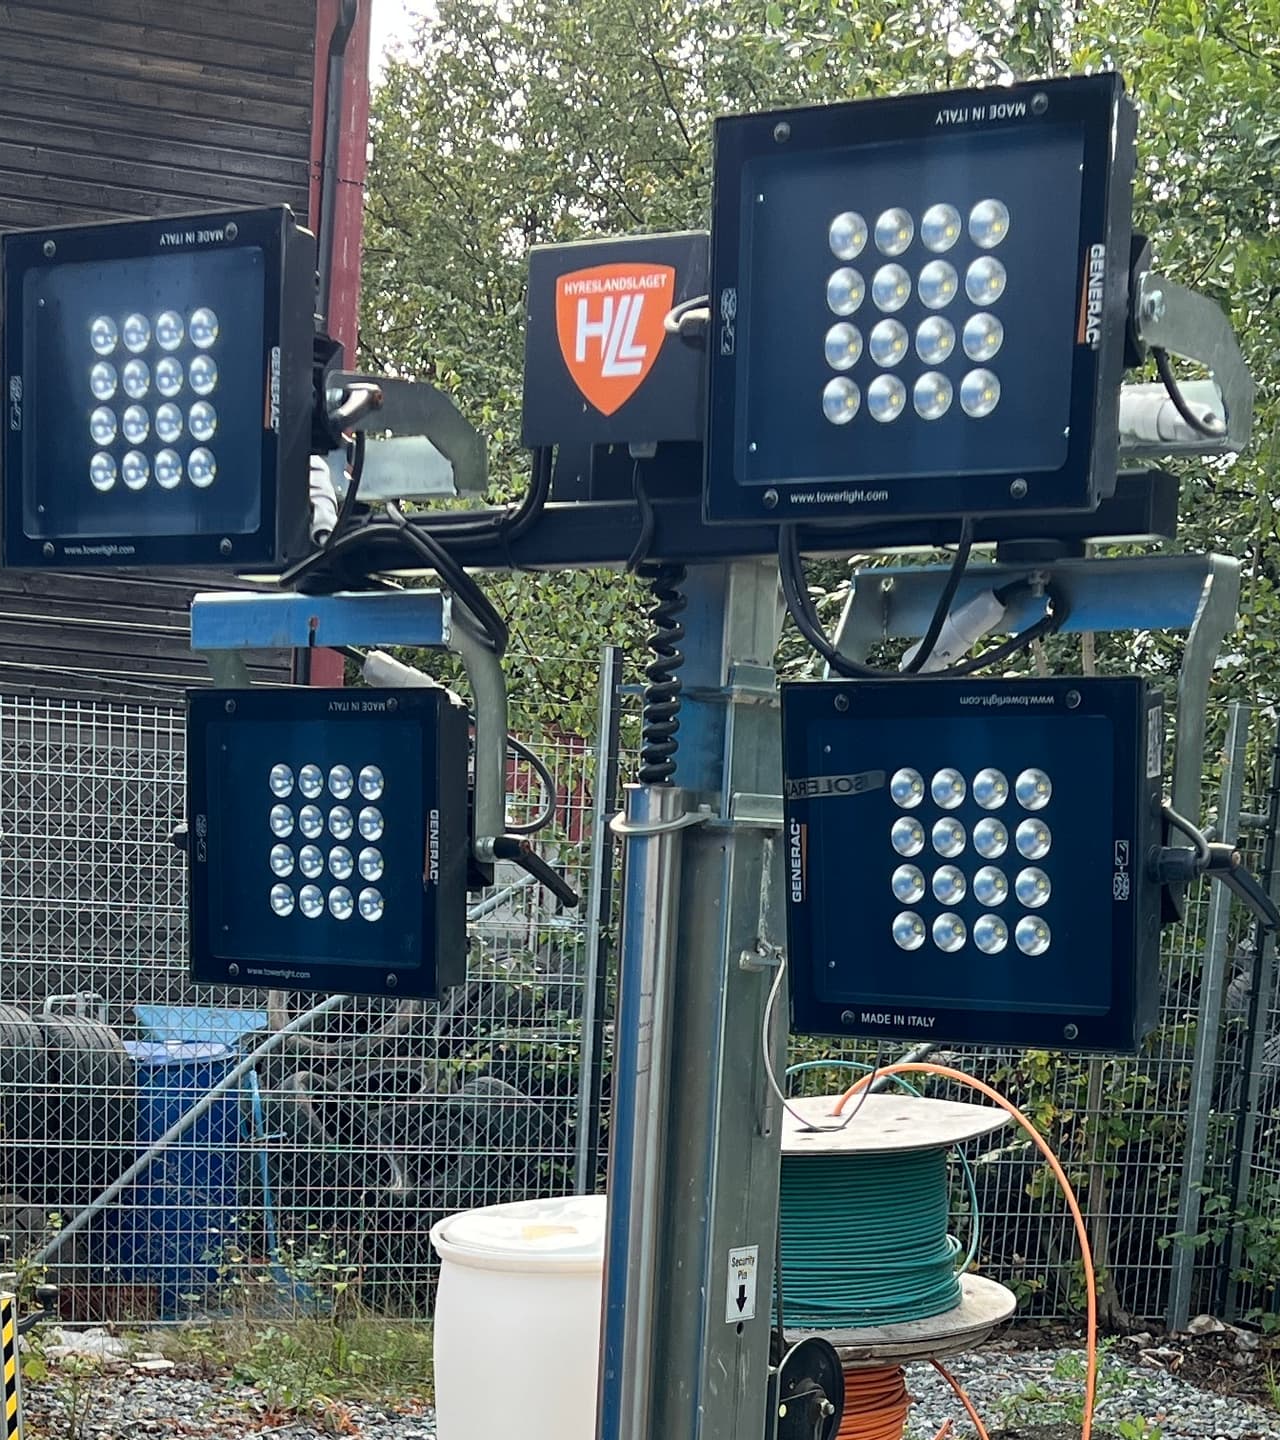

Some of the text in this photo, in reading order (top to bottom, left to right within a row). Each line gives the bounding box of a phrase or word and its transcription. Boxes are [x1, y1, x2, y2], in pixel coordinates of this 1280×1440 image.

[935, 103, 1026, 125] MADE IN ITALY
[160, 229, 224, 246] MADE IN ITALY
[564, 273, 667, 296] HYRESLANDSLAGET
[1085, 243, 1106, 344] GENERAC
[575, 293, 647, 378] HLL
[270, 346, 280, 429] GENERAC
[790, 489, 889, 504] www.towerlight.com
[328, 701, 386, 711] MADE IN ITALY
[959, 693, 1055, 706] www.towerlight.com
[429, 809, 440, 881] GENERAC
[790, 823, 802, 903] GENERAC
[861, 1012, 935, 1028] MADE IN ITALY
